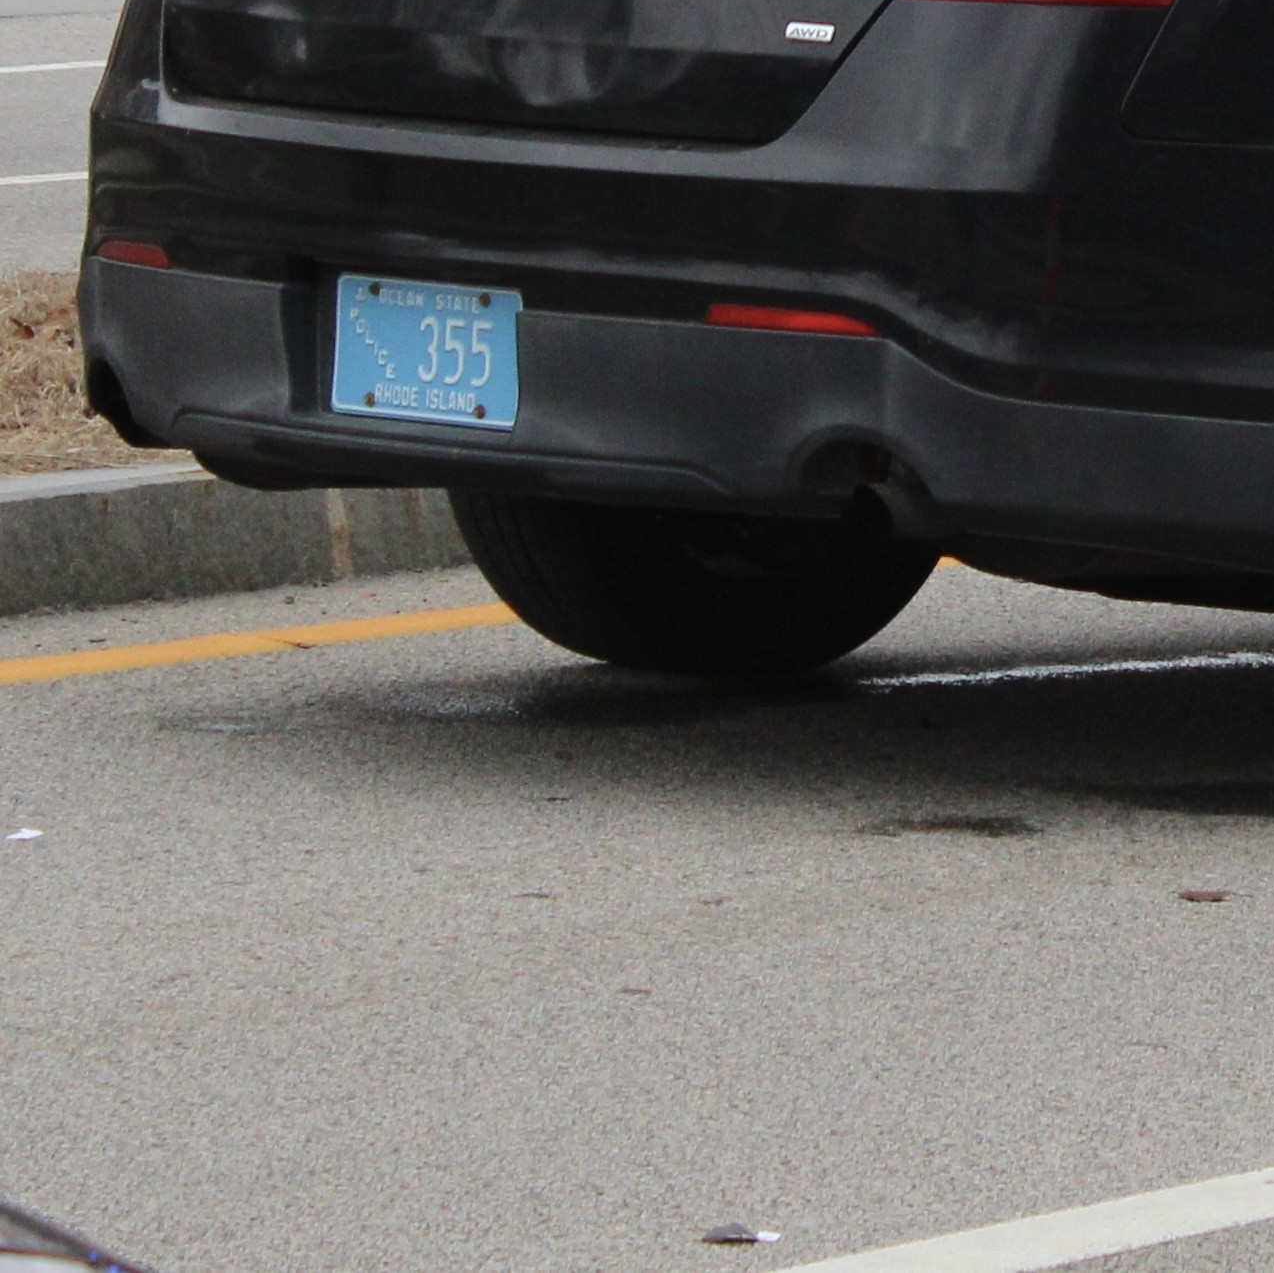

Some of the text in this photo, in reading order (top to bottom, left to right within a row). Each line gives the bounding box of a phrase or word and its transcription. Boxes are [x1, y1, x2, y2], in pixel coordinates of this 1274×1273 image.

[788, 27, 829, 39] AWD
[379, 287, 480, 314] OCEAN STATE
[350, 306, 397, 380] POLICE
[417, 315, 494, 389] 355
[374, 383, 477, 415] RHODE ISLAND
